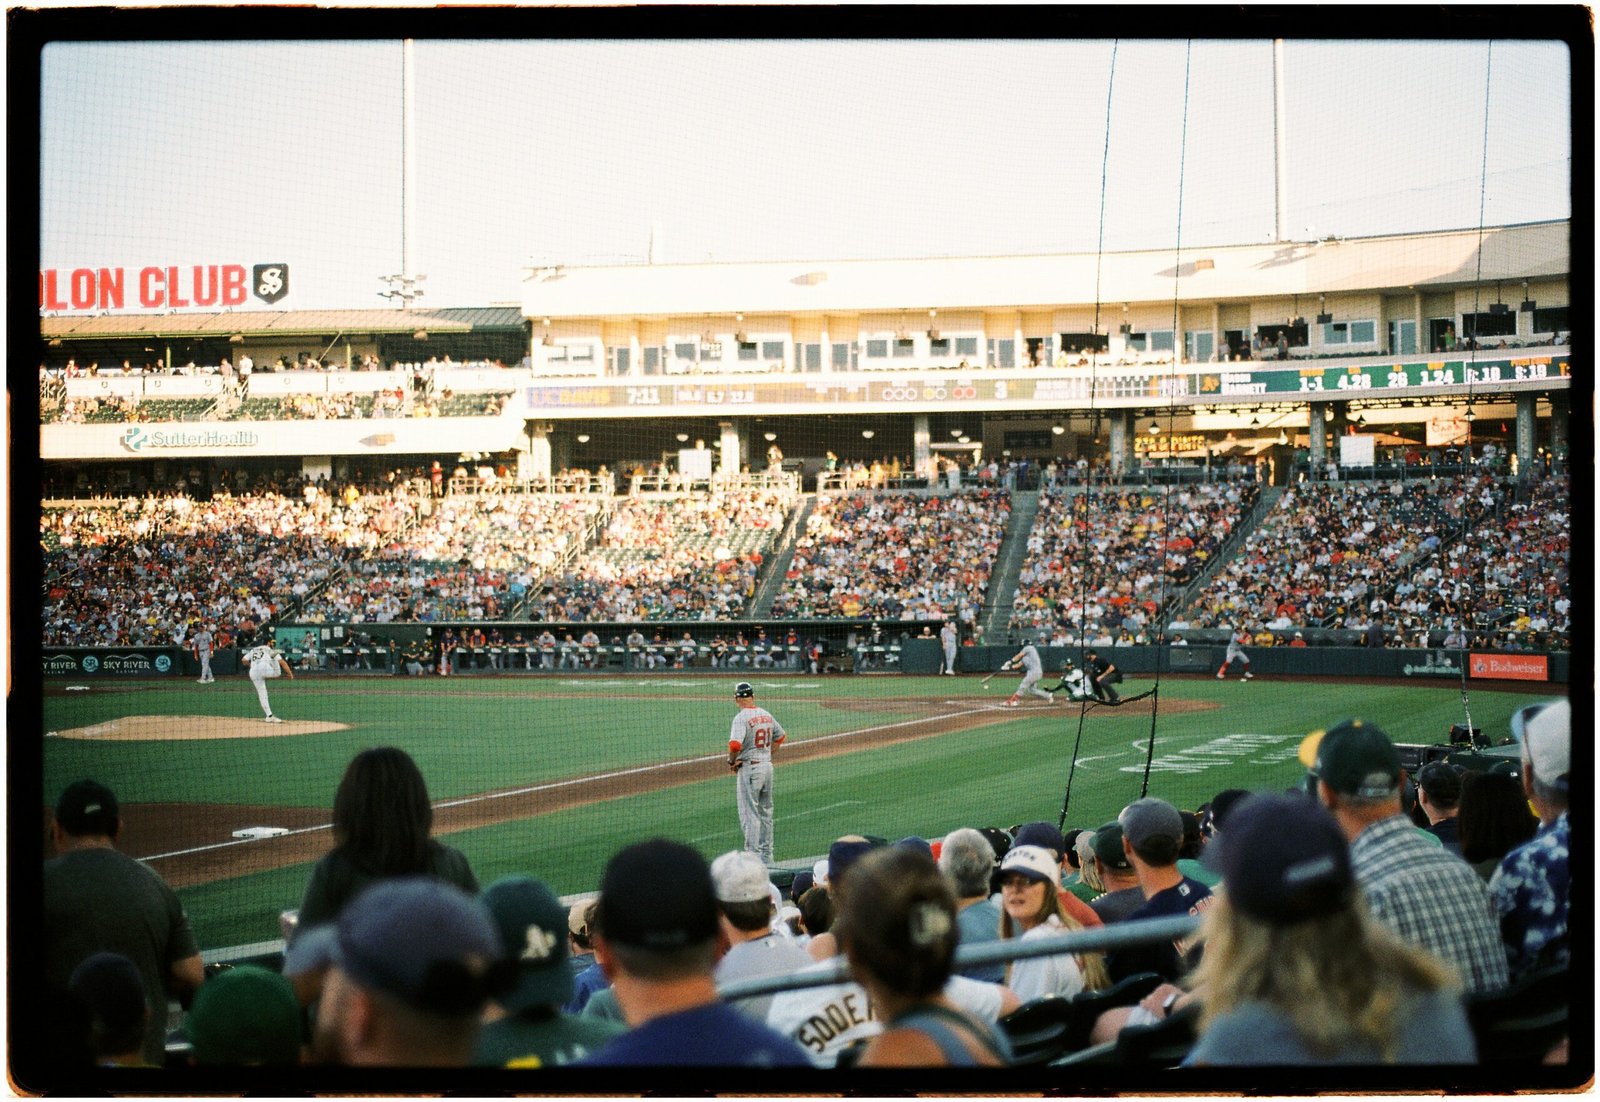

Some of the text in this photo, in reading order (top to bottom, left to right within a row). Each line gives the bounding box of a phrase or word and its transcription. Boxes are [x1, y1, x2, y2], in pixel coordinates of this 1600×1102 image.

[40, 264, 247, 310] LON CLUB
[51, 662, 77, 670] RIVER
[103, 661, 151, 670] SKY RIVER
[1490, 660, 1545, 674] Budweiser
[754, 728, 771, 748] 81
[799, 994, 874, 1053] SODE
